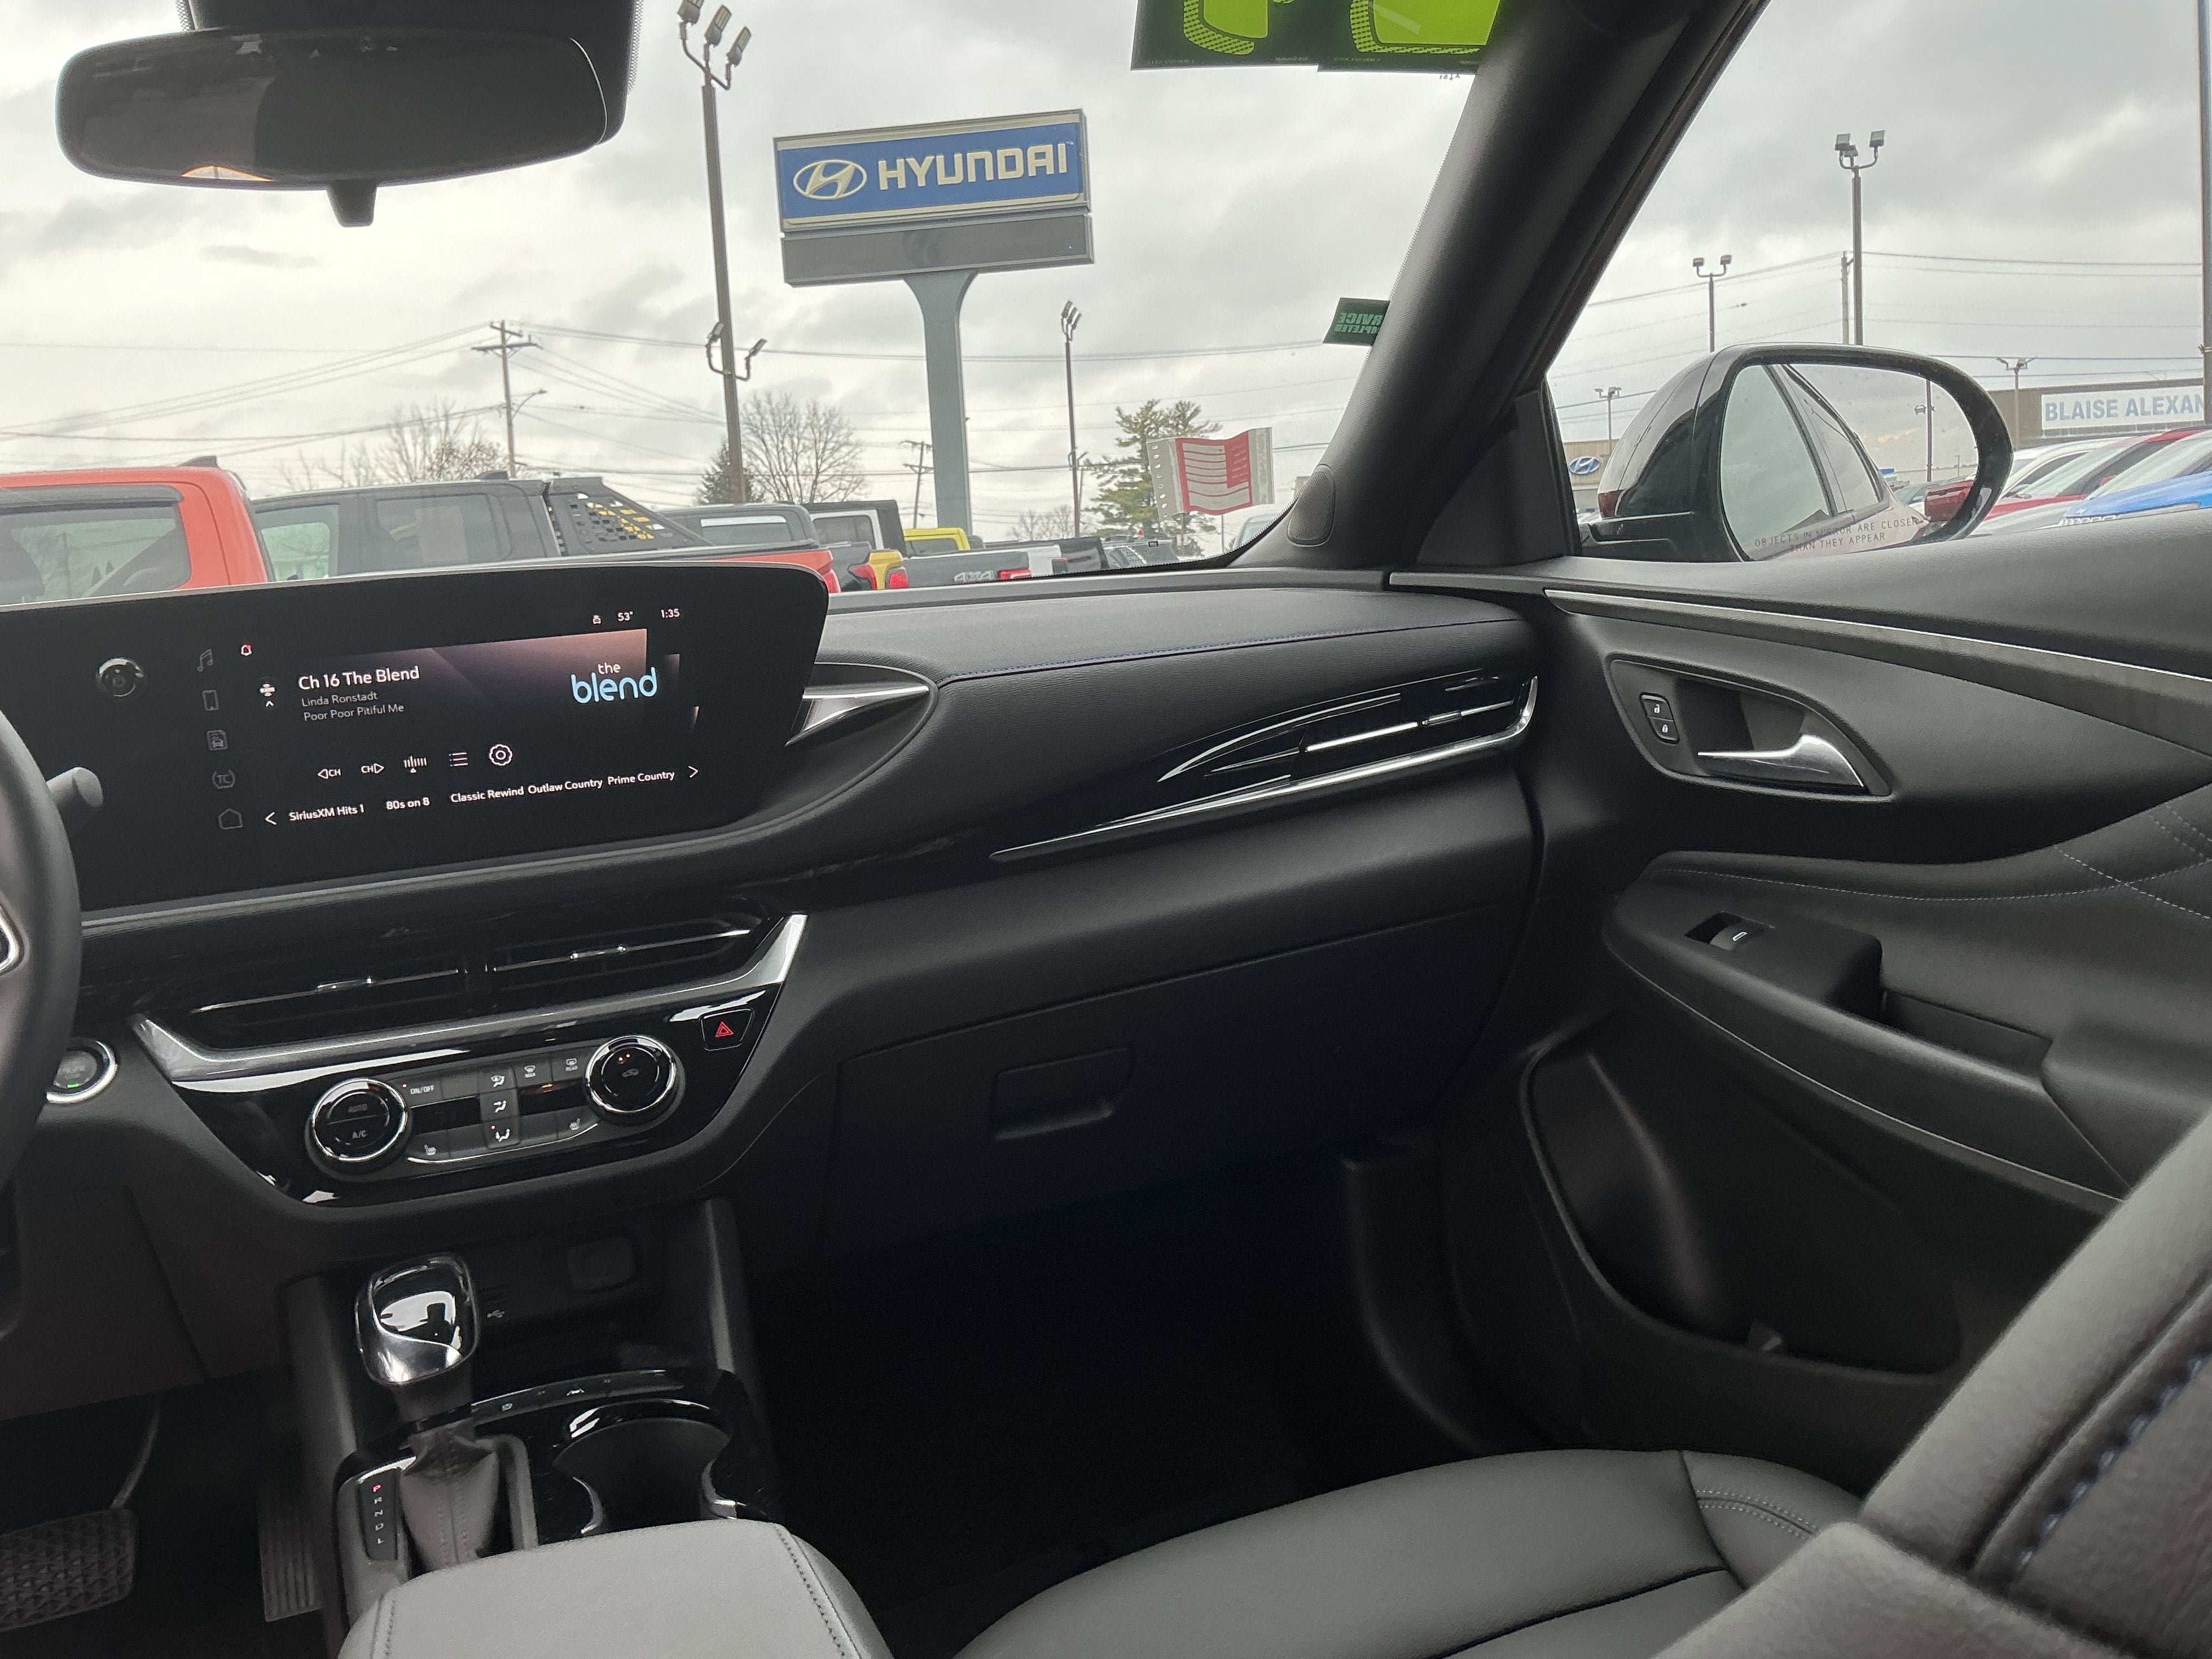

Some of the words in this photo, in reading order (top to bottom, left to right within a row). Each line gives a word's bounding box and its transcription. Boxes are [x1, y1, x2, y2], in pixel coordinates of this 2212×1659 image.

[878, 143, 1068, 190] HYUNDAI
[2045, 399, 2118, 421] BLAISE
[1754, 533, 1799, 547] OBJECTS
[1803, 531, 1812, 539] IN
[1858, 522, 1875, 533] ARE
[1881, 517, 1918, 529] CLOSER
[1819, 537, 1844, 549] THEY
[1849, 533, 1886, 545] APPEAR
[617, 611, 634, 622] 53°
[661, 608, 680, 619] 1:35
[597, 662, 621, 675] the
[298, 675, 320, 690] Ch
[323, 673, 340, 687] 16
[342, 671, 373, 686] The
[375, 665, 420, 682] Blend
[571, 667, 658, 704] blend
[301, 696, 329, 707] Linda
[331, 691, 378, 704] Ronstadt
[303, 712, 328, 721] Poor
[330, 709, 354, 719] Poor
[357, 705, 386, 716] Pitiful
[388, 703, 405, 714] Me
[329, 768, 342, 777] CH
[360, 765, 374, 774] CH
[607, 776, 636, 785] Prime
[637, 771, 675, 782] Country
[450, 792, 486, 803] Classic
[487, 786, 524, 799] Rewind
[528, 783, 563, 794] Outlaw
[565, 780, 603, 790] Country
[386, 800, 406, 810] 80s
[408, 799, 421, 808] on
[422, 797, 430, 806] 8
[289, 807, 335, 821] SiriusXM
[337, 805, 358, 816] Hits
[359, 803, 365, 813] 1
[409, 1084, 435, 1094] ON/OFF
[352, 1129, 369, 1139] A/C
